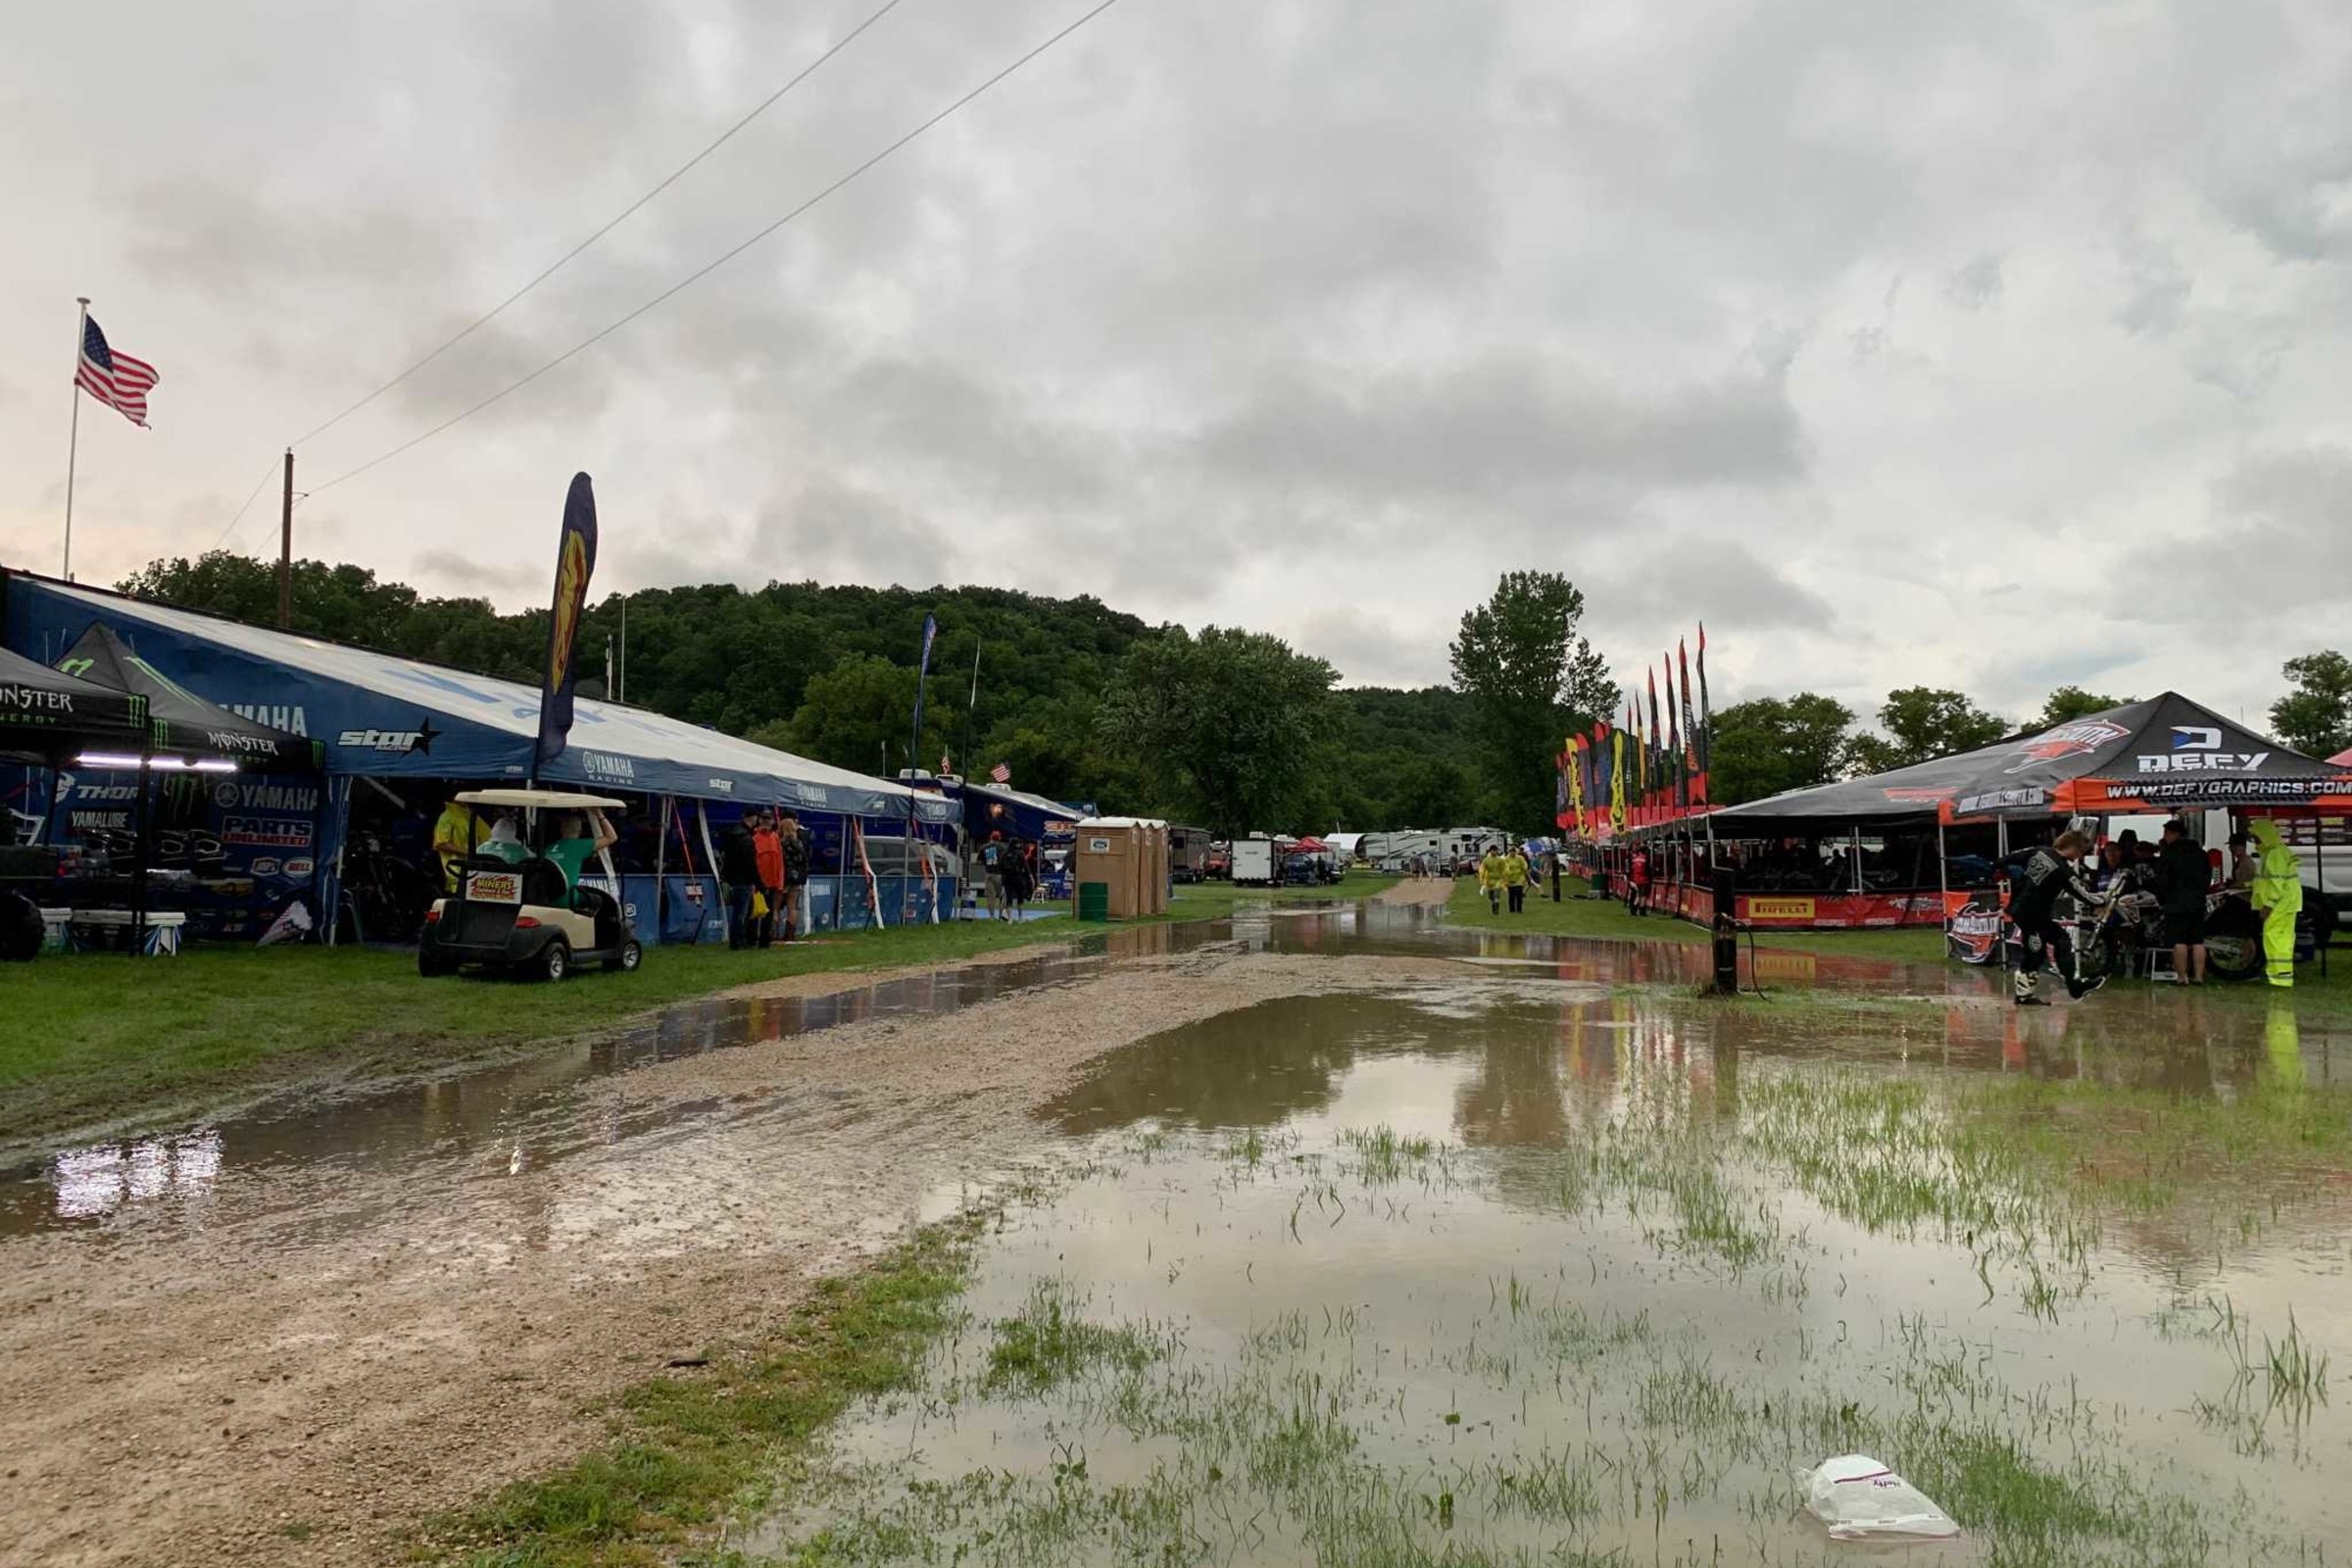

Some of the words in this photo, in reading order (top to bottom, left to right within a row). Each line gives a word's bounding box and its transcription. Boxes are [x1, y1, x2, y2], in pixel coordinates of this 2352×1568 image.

[0, 684, 74, 713] NSTER
[218, 704, 308, 738] MAHA
[207, 731, 279, 756] MONSTER
[594, 755, 636, 778] YAMAHA
[2136, 753, 2270, 772] DEFY
[241, 784, 318, 811] YAMAHA
[2107, 781, 2352, 799] WWW.DEFYGRAPHICS.COM
[224, 817, 312, 836] PARTS
[1754, 903, 1809, 913] PIRELLI
